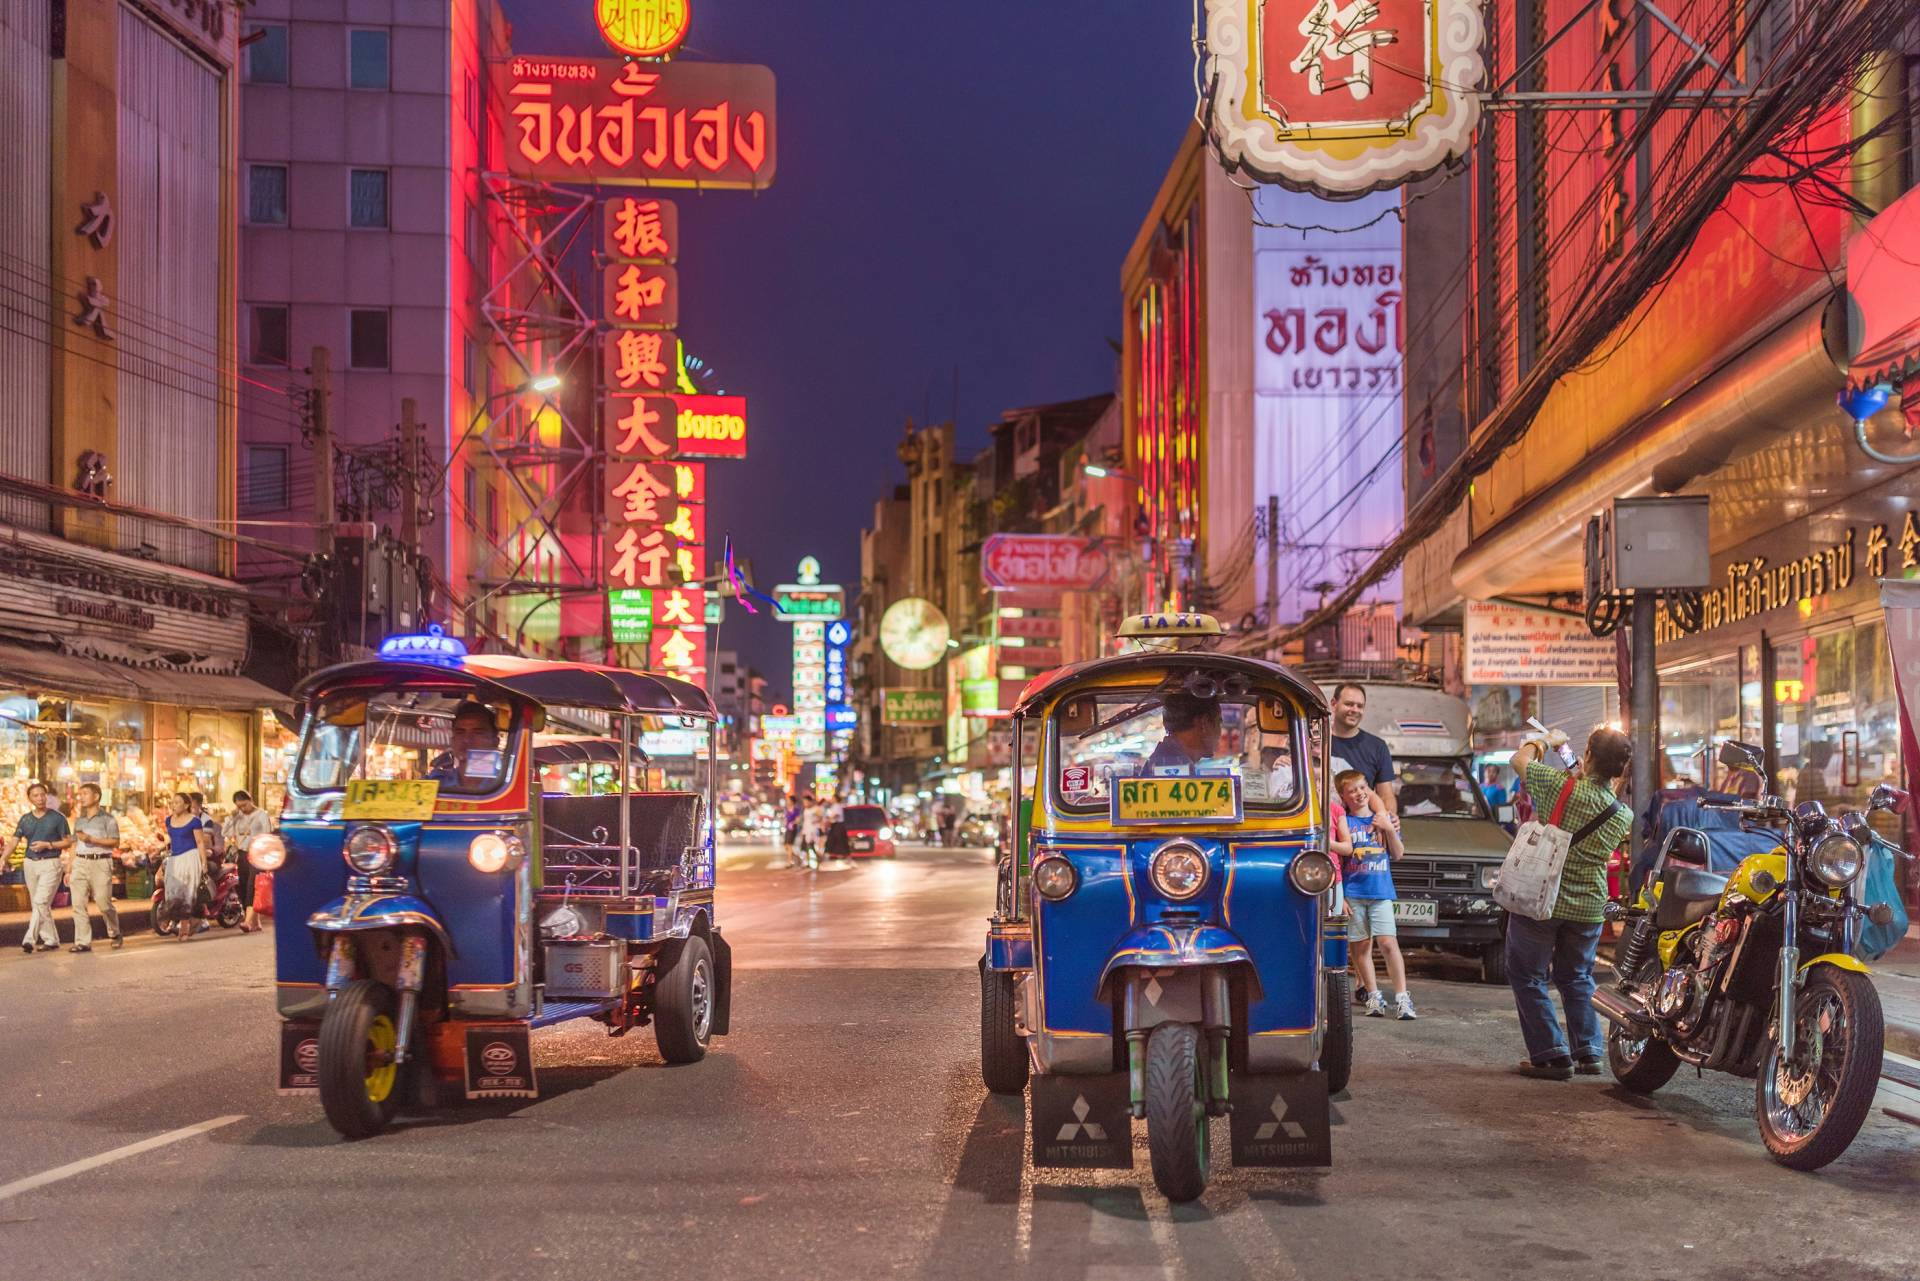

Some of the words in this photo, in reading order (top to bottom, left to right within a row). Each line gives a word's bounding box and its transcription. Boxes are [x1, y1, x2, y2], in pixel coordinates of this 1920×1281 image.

[512, 58, 596, 79] ห้างขายทอง
[1289, 256, 1402, 287] ห้างทอ
[610, 197, 671, 587] 振和興大金行
[1141, 614, 1202, 629] TAXI
[394, 637, 444, 650] TAXI
[1169, 781, 1230, 803] 4074
[1405, 903, 1434, 915] 7204
[564, 962, 583, 974] GS
